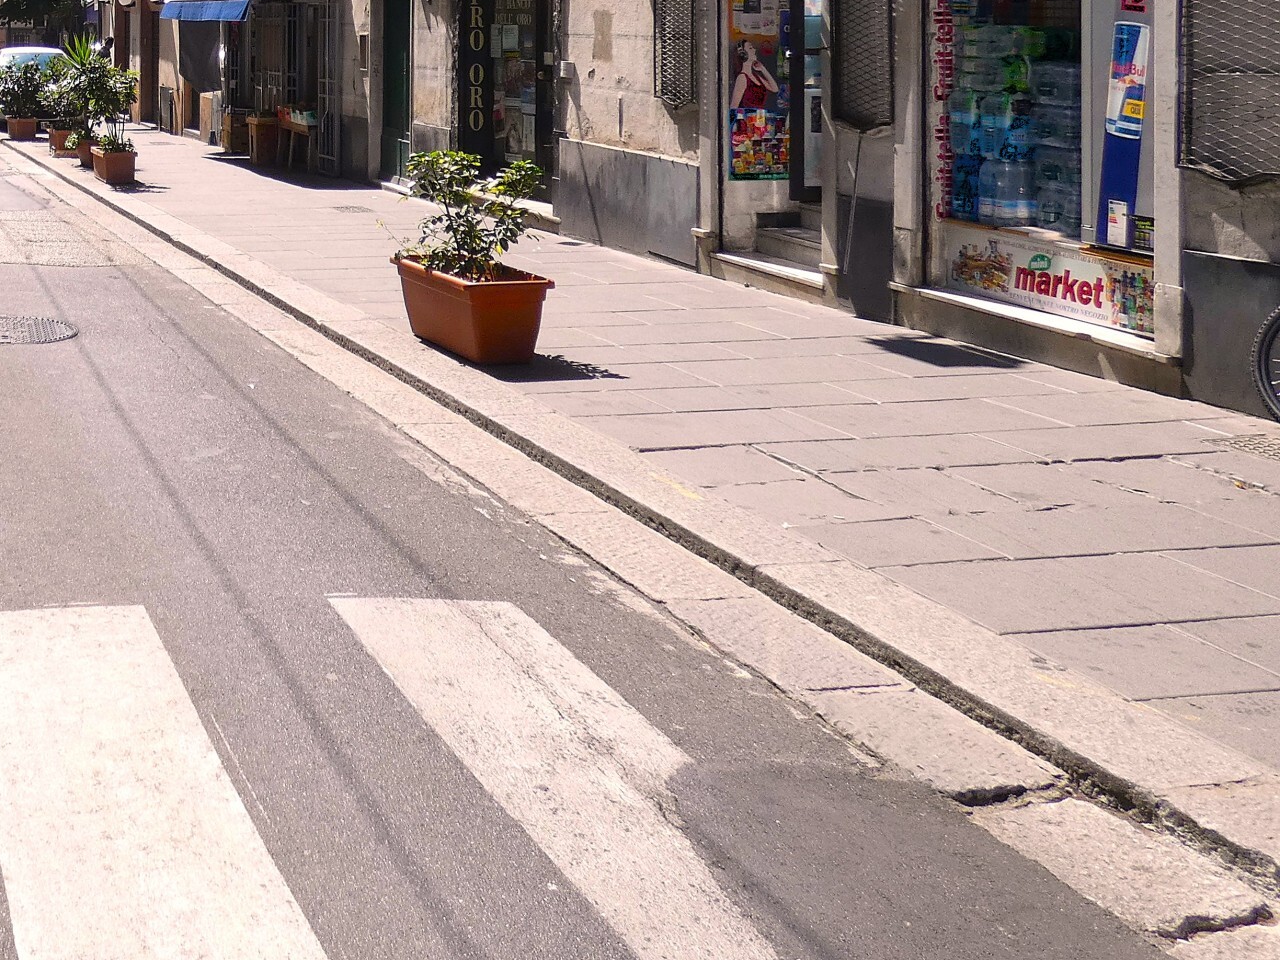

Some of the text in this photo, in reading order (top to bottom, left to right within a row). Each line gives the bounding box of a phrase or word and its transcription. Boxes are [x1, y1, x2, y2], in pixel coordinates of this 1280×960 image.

[516, 13, 532, 25] ORO
[1130, 63, 1146, 78] Bull
[469, 62, 485, 132] ORO
[1029, 255, 1048, 270] mini
[1014, 265, 1104, 309] market
[1080, 308, 1109, 321] NEGOZIO
